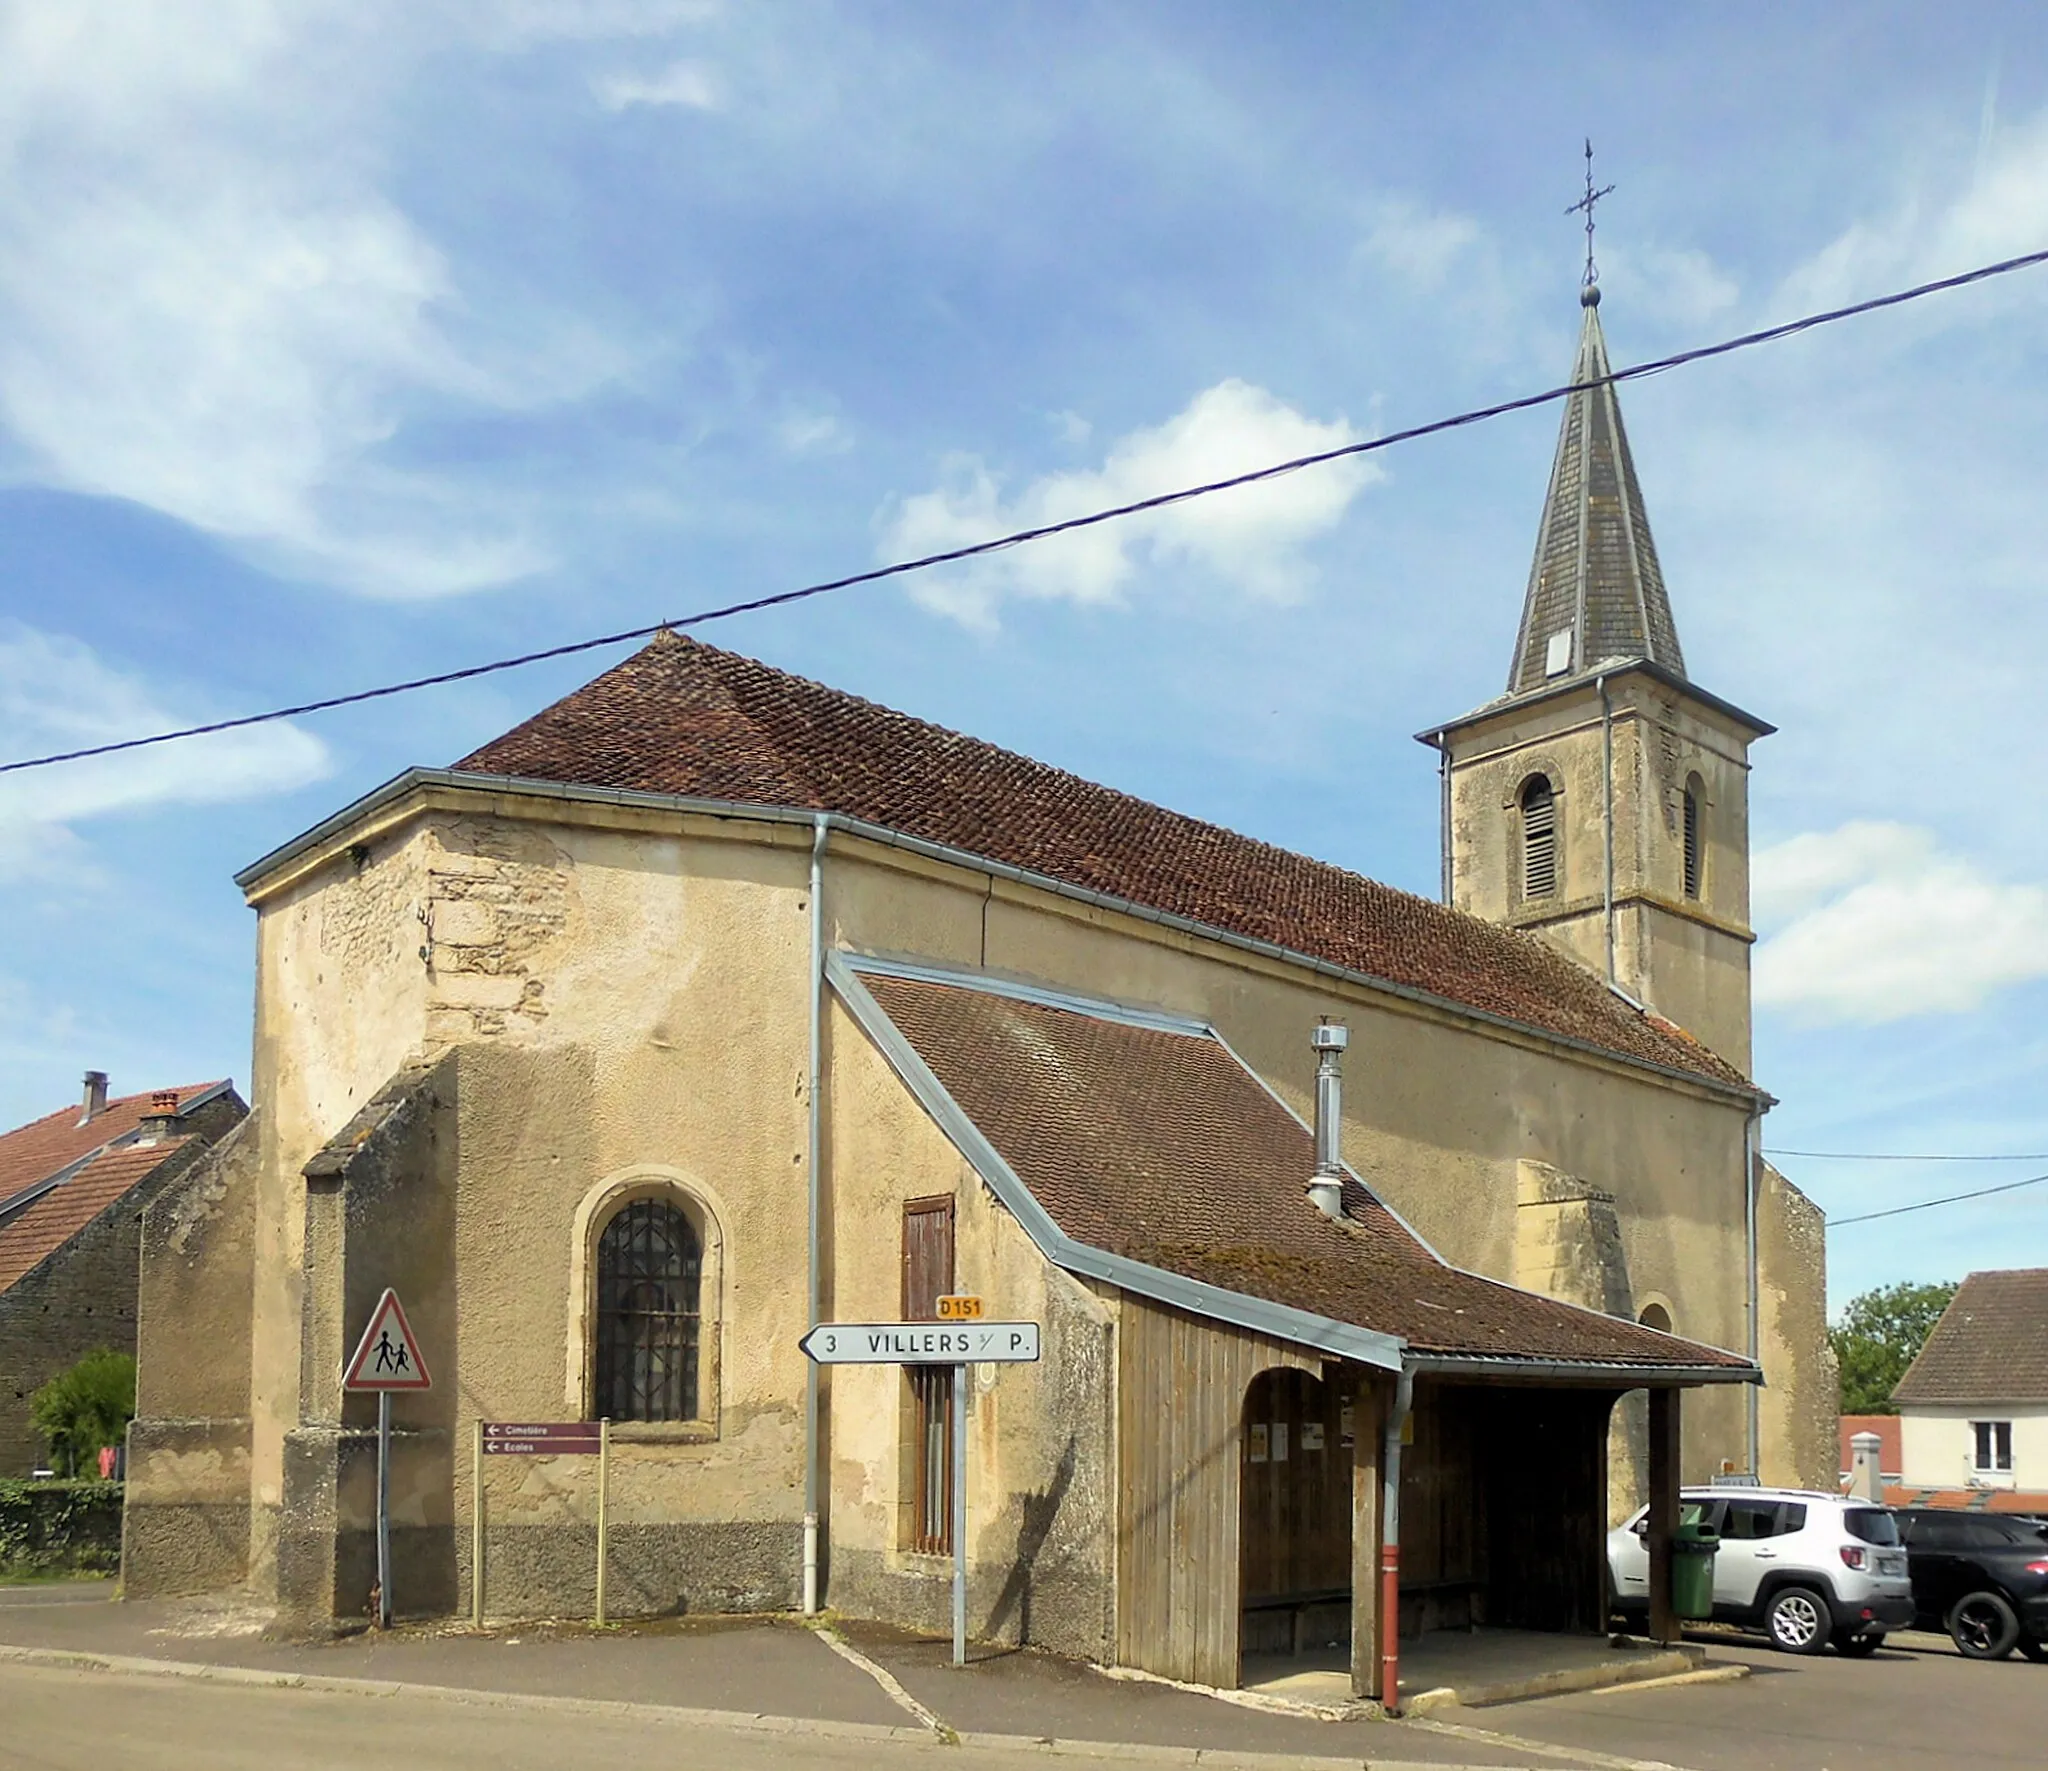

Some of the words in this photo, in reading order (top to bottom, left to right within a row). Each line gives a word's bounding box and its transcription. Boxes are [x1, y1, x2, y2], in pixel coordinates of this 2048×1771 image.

[826, 1334, 837, 1353] 3
[868, 1333, 970, 1353] VILLERS
[1010, 1333, 1030, 1351] P.
[504, 1442, 534, 1452] Ecoles
